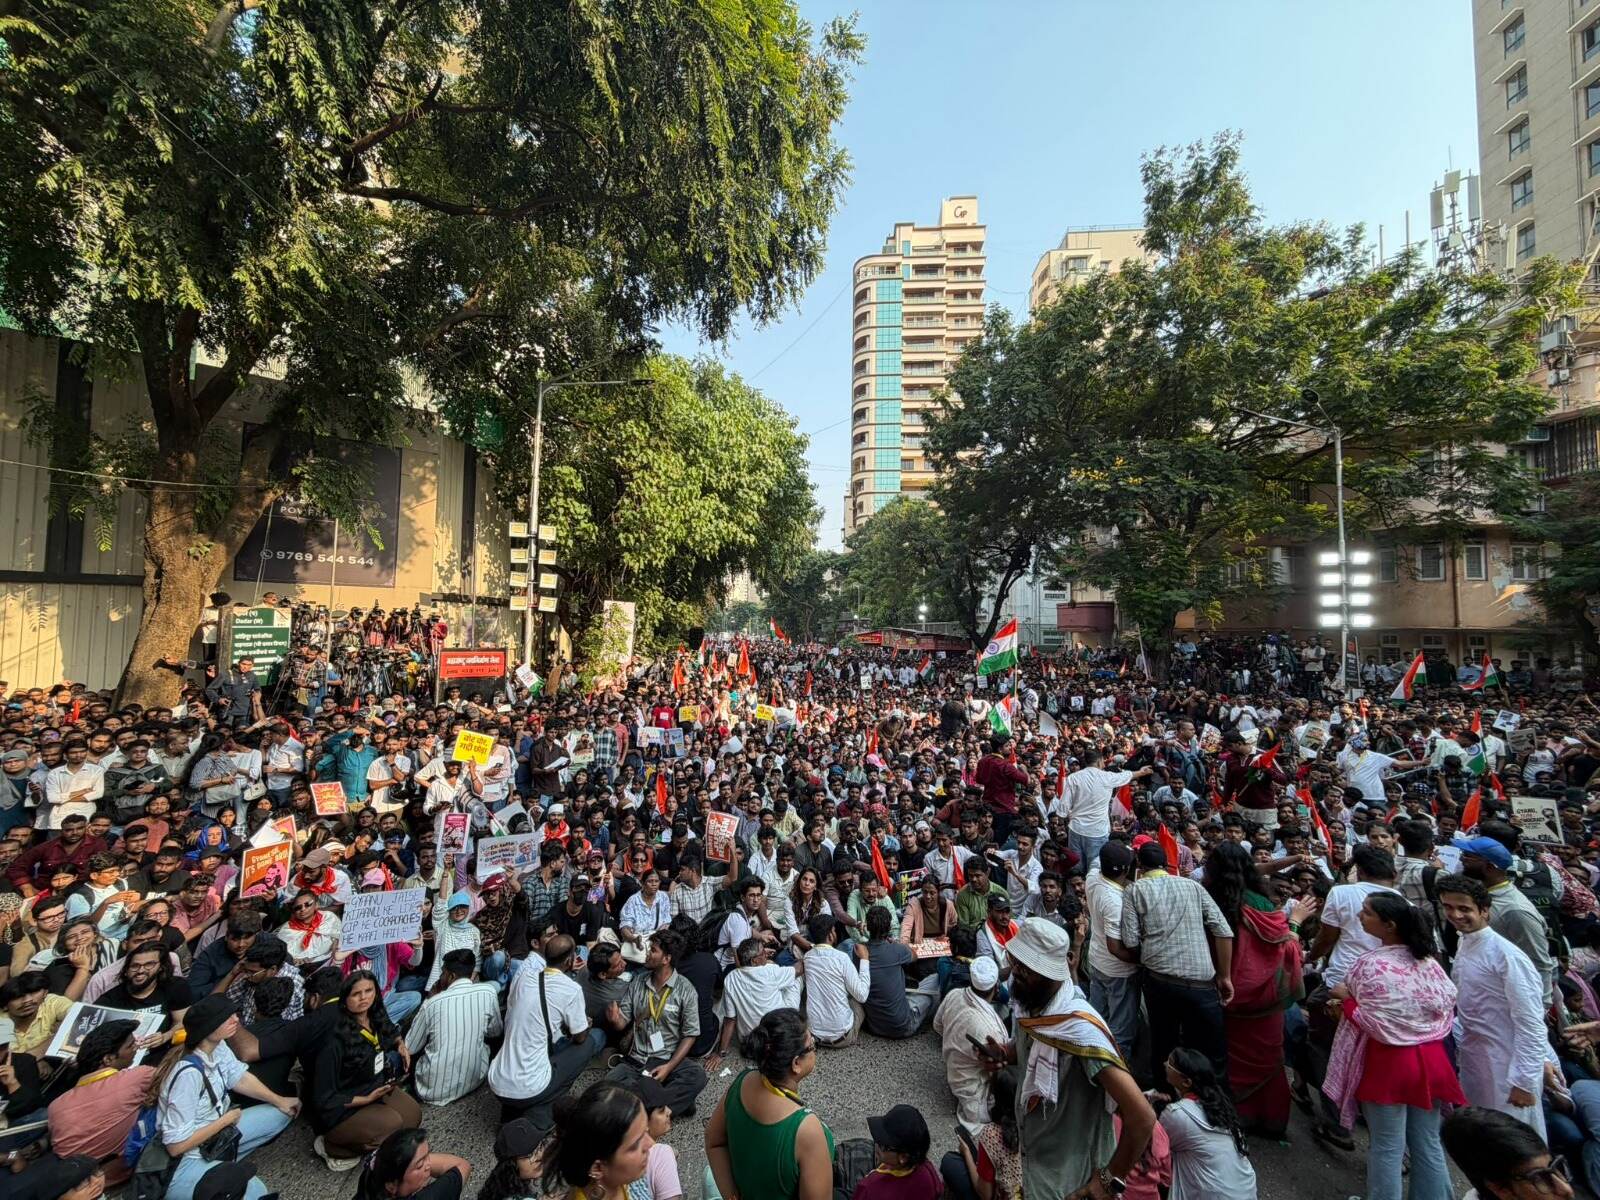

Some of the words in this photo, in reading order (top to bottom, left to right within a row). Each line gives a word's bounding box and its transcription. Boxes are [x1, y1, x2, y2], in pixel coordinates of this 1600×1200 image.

[276, 551, 313, 562] 9769
[317, 553, 344, 564] 544
[348, 556, 375, 566] 544
